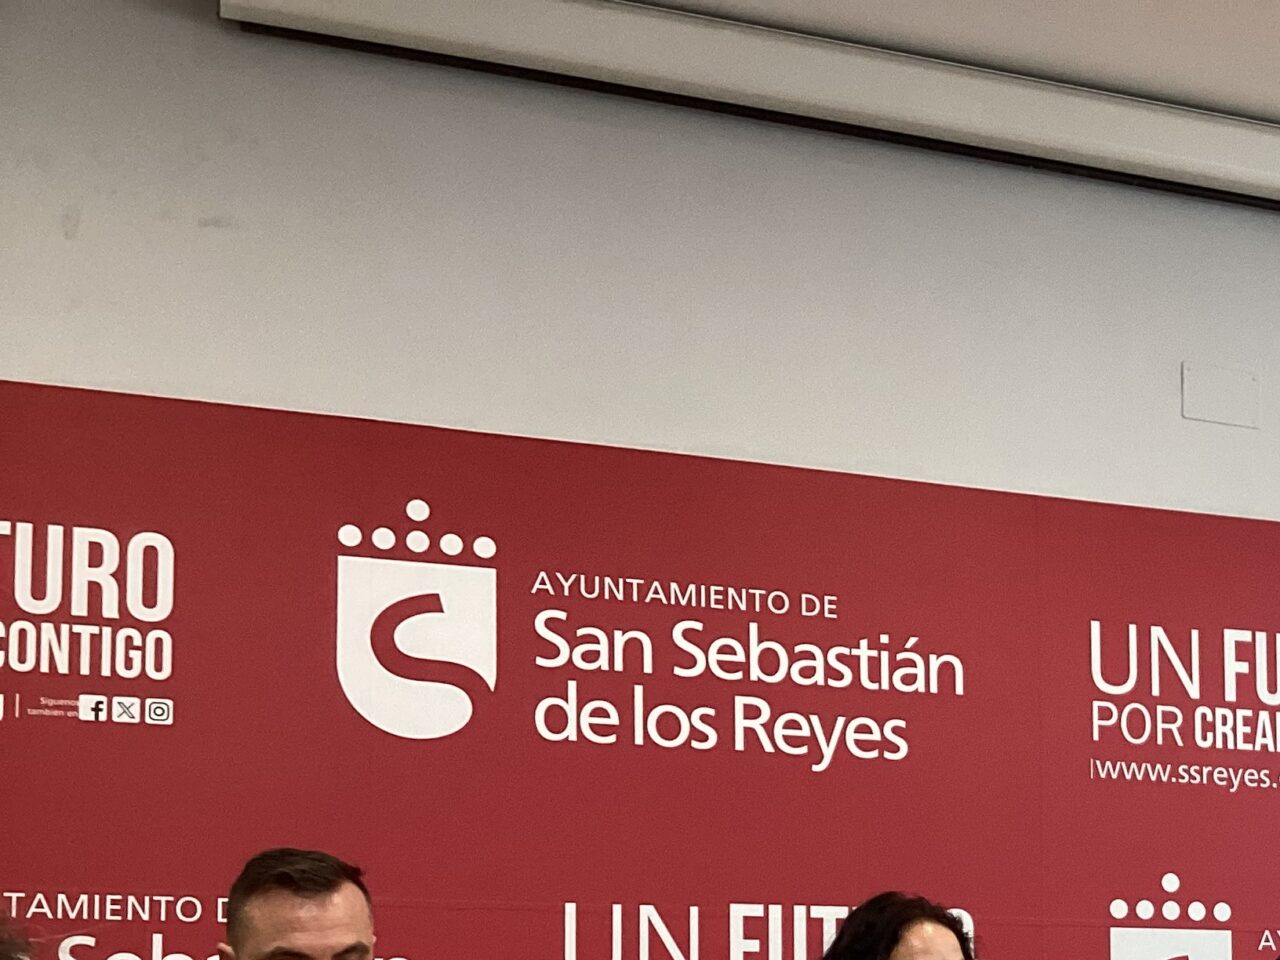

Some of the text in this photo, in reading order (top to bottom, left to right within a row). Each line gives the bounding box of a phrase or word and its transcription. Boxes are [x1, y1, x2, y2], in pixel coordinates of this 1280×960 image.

[531, 570, 838, 618] AYUNTAMIENTO DE
[534, 610, 964, 695] San Sebastián
[1090, 620, 1200, 700] UN
[534, 680, 909, 772] de los Reyes
[1092, 701, 1184, 746] POR
